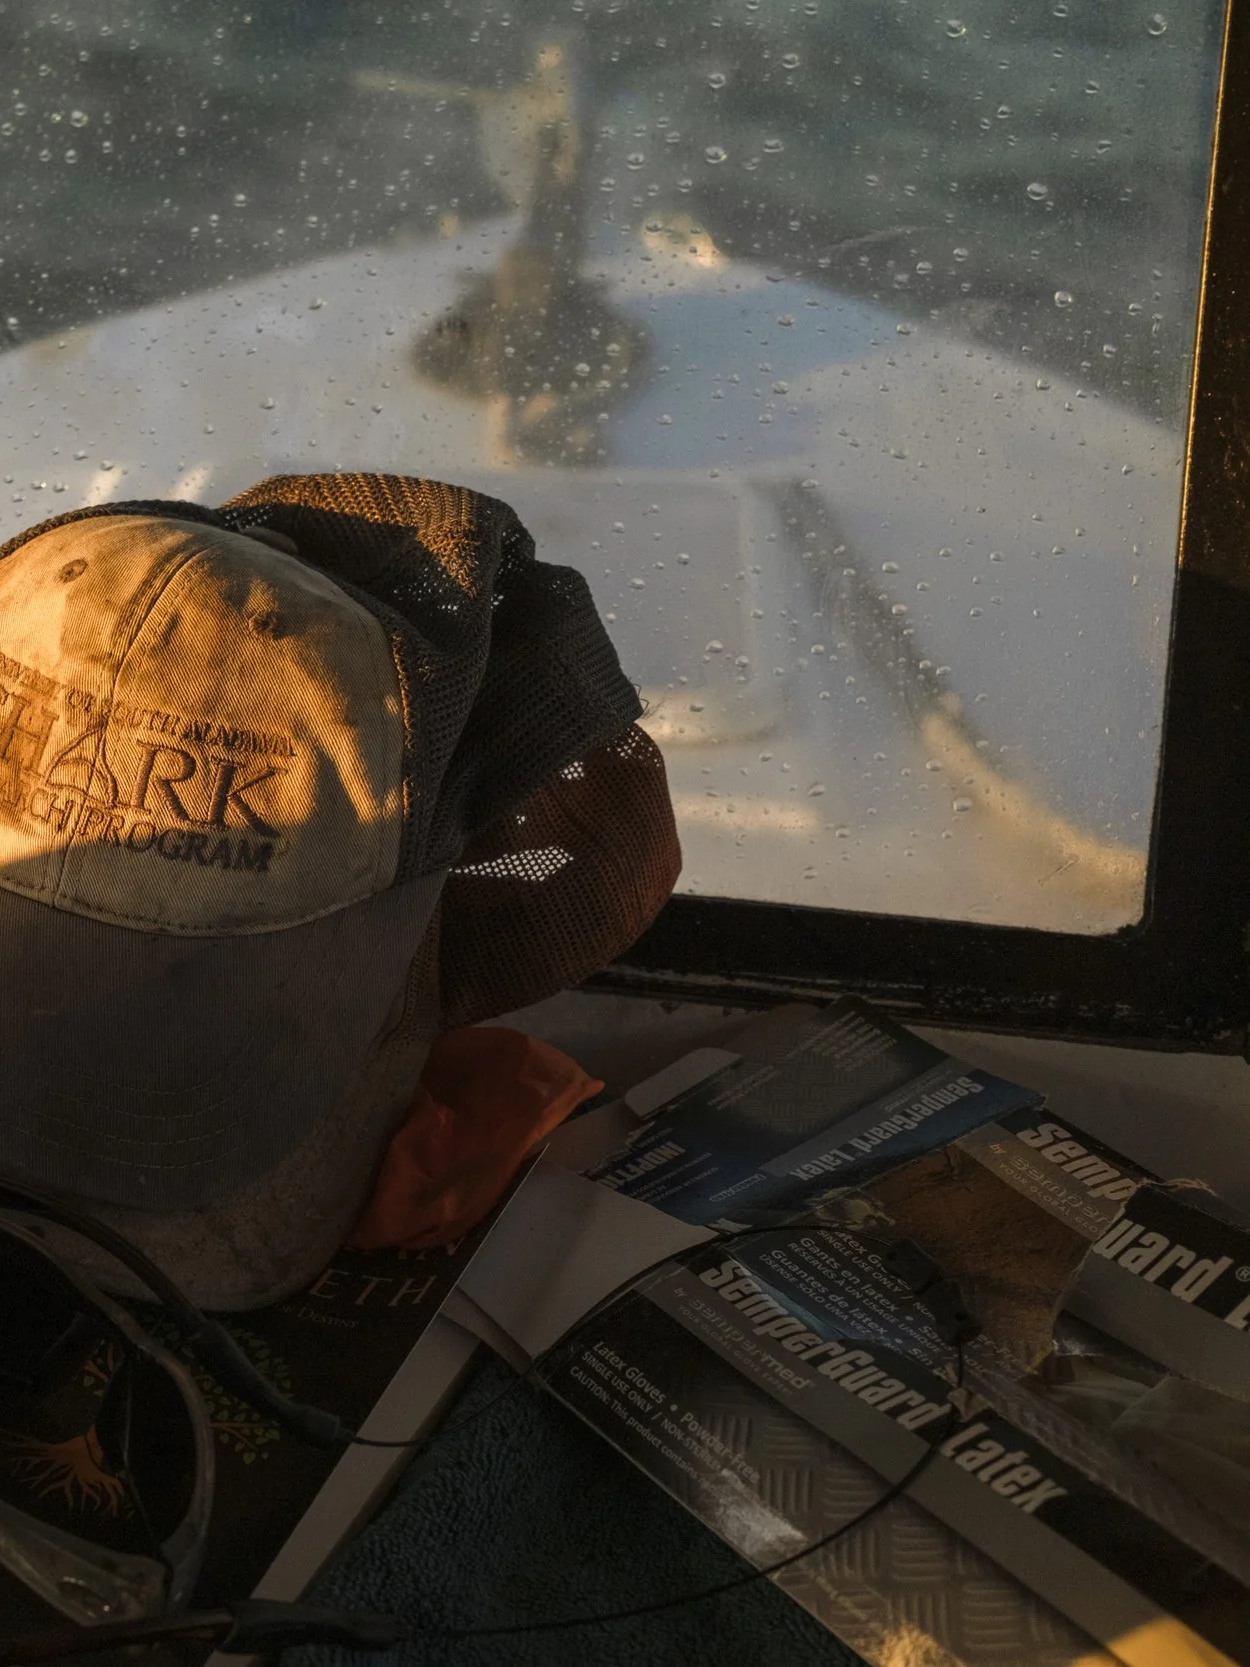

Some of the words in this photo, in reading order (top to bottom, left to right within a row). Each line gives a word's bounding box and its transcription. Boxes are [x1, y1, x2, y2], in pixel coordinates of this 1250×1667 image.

[73, 806, 274, 873] PROGRAM
[788, 1146, 854, 1183] Latex
[799, 1237, 841, 1270] Gants
[841, 1270, 860, 1285] en
[862, 1283, 898, 1312] latex
[817, 1230, 852, 1257] SINGLE
[852, 1256, 872, 1273] USE
[872, 1271, 901, 1294] ONLY
[770, 1249, 828, 1294] Guantes
[827, 1293, 849, 1309] de
[909, 1346, 933, 1365] Sin
[824, 1303, 848, 1321] UNA
[845, 1287, 864, 1301] UN
[863, 1299, 899, 1325] USAGE
[899, 1323, 941, 1354] UNIQUE
[582, 1352, 612, 1380] SINGLE
[611, 1376, 629, 1394] USE
[627, 1391, 651, 1411] ONLY
[592, 1341, 627, 1370] Latex
[623, 1365, 666, 1403] Gloves
[680, 1411, 762, 1483] Powder-Free
[698, 1256, 954, 1436] SemperGuard
[937, 1423, 1070, 1515] Latex
[569, 1366, 611, 1403] CAUTION:
[610, 1399, 629, 1419] This
[625, 1417, 662, 1447] product
[660, 1445, 698, 1478] contains
